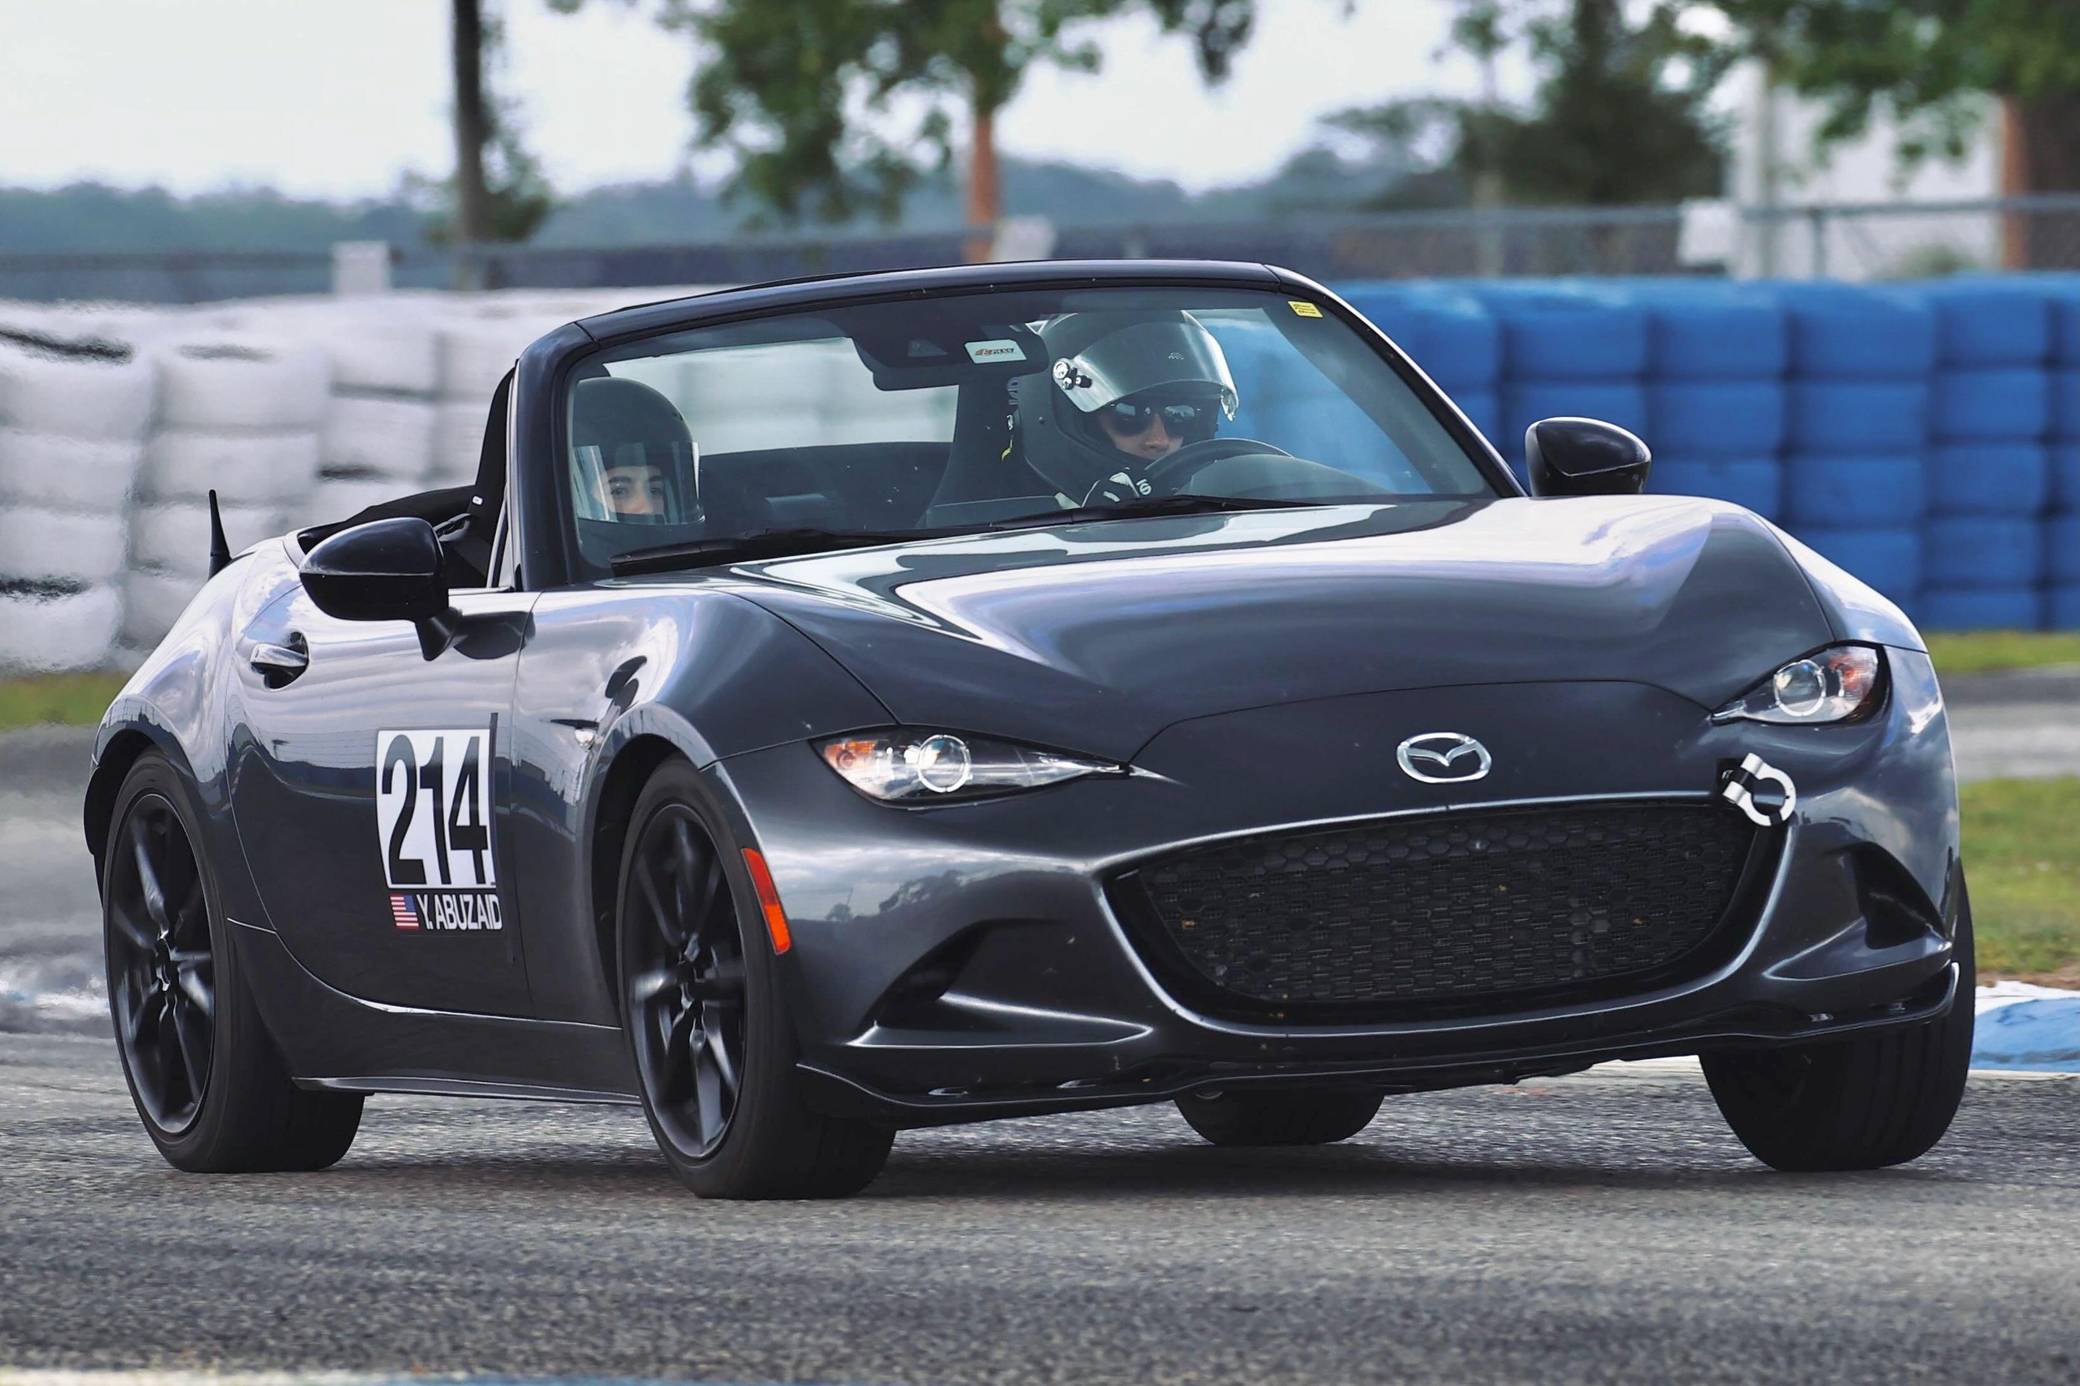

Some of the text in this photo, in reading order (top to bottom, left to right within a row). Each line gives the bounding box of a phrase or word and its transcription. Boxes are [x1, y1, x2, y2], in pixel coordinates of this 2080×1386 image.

[381, 734, 488, 885] 214
[416, 894, 503, 930] Y. ABUZAID
